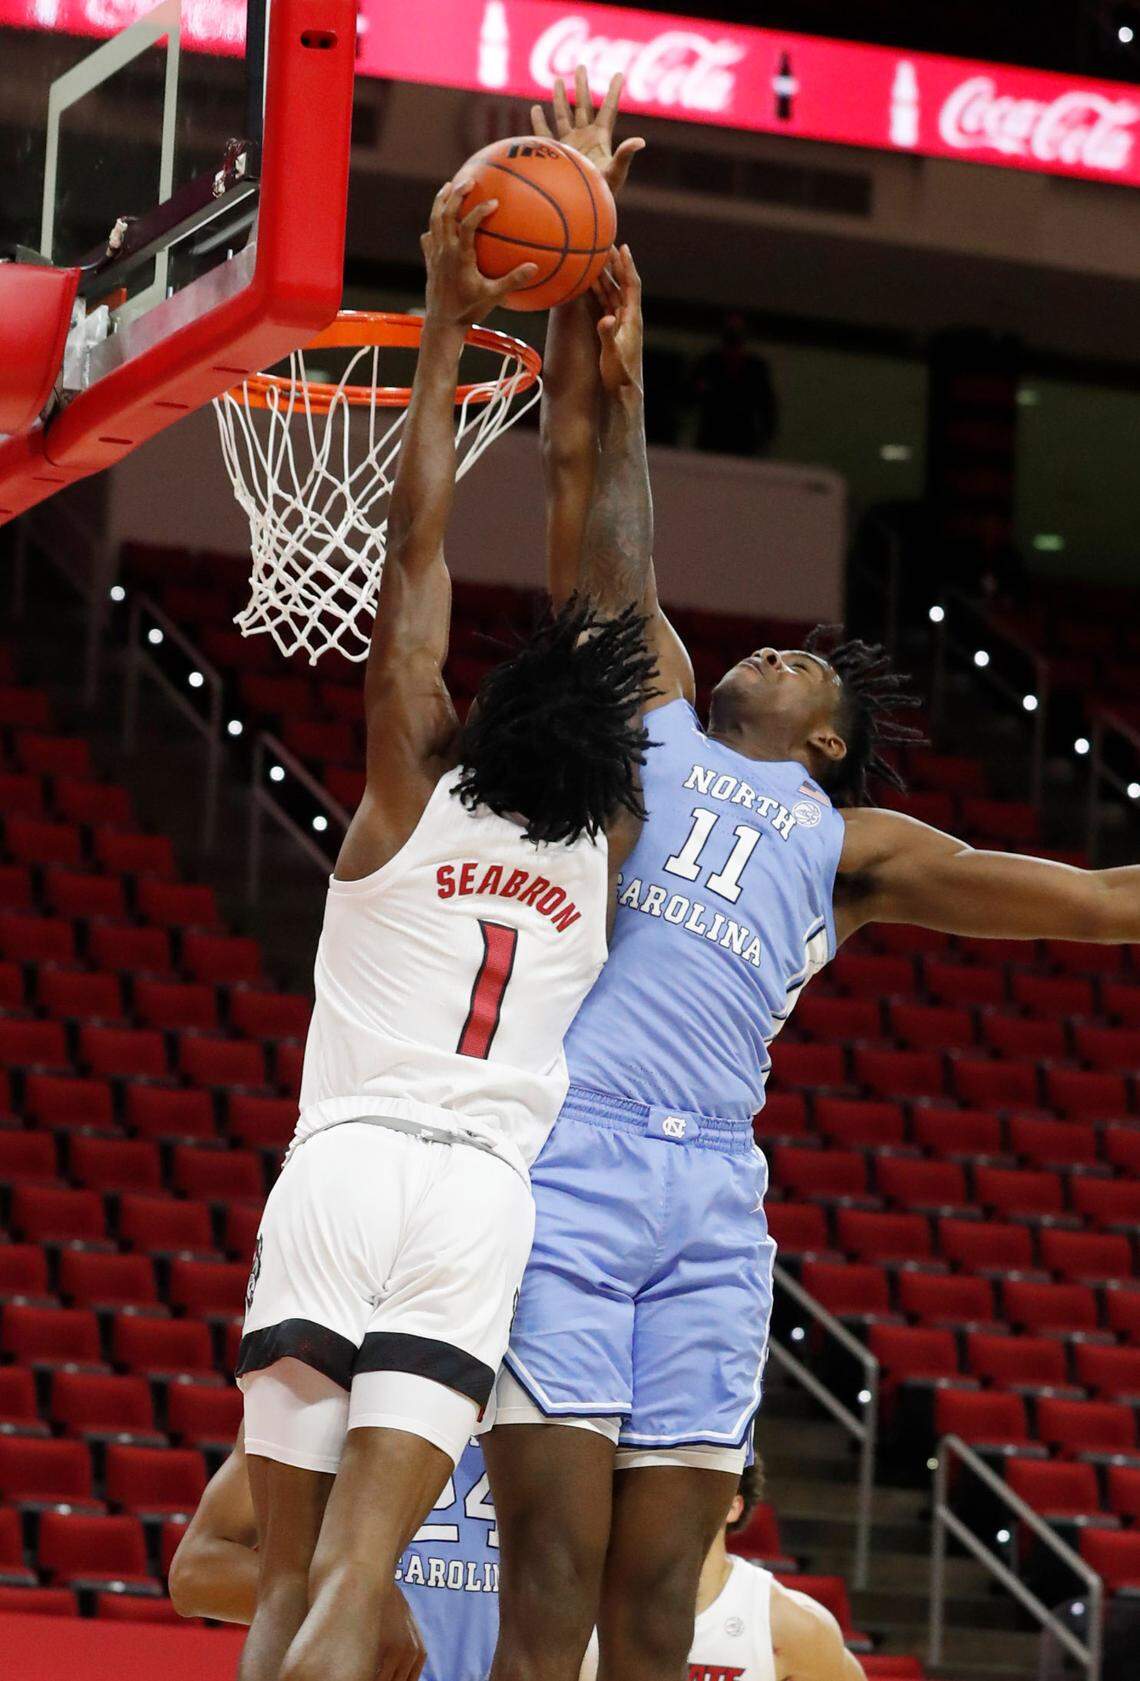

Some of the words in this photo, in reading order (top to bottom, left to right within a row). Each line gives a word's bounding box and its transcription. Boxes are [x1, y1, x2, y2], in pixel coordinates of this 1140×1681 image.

[684, 765, 796, 841] NORTH
[436, 863, 582, 933] SEABRON
[662, 807, 762, 904] 11
[455, 919, 518, 1060] 1
